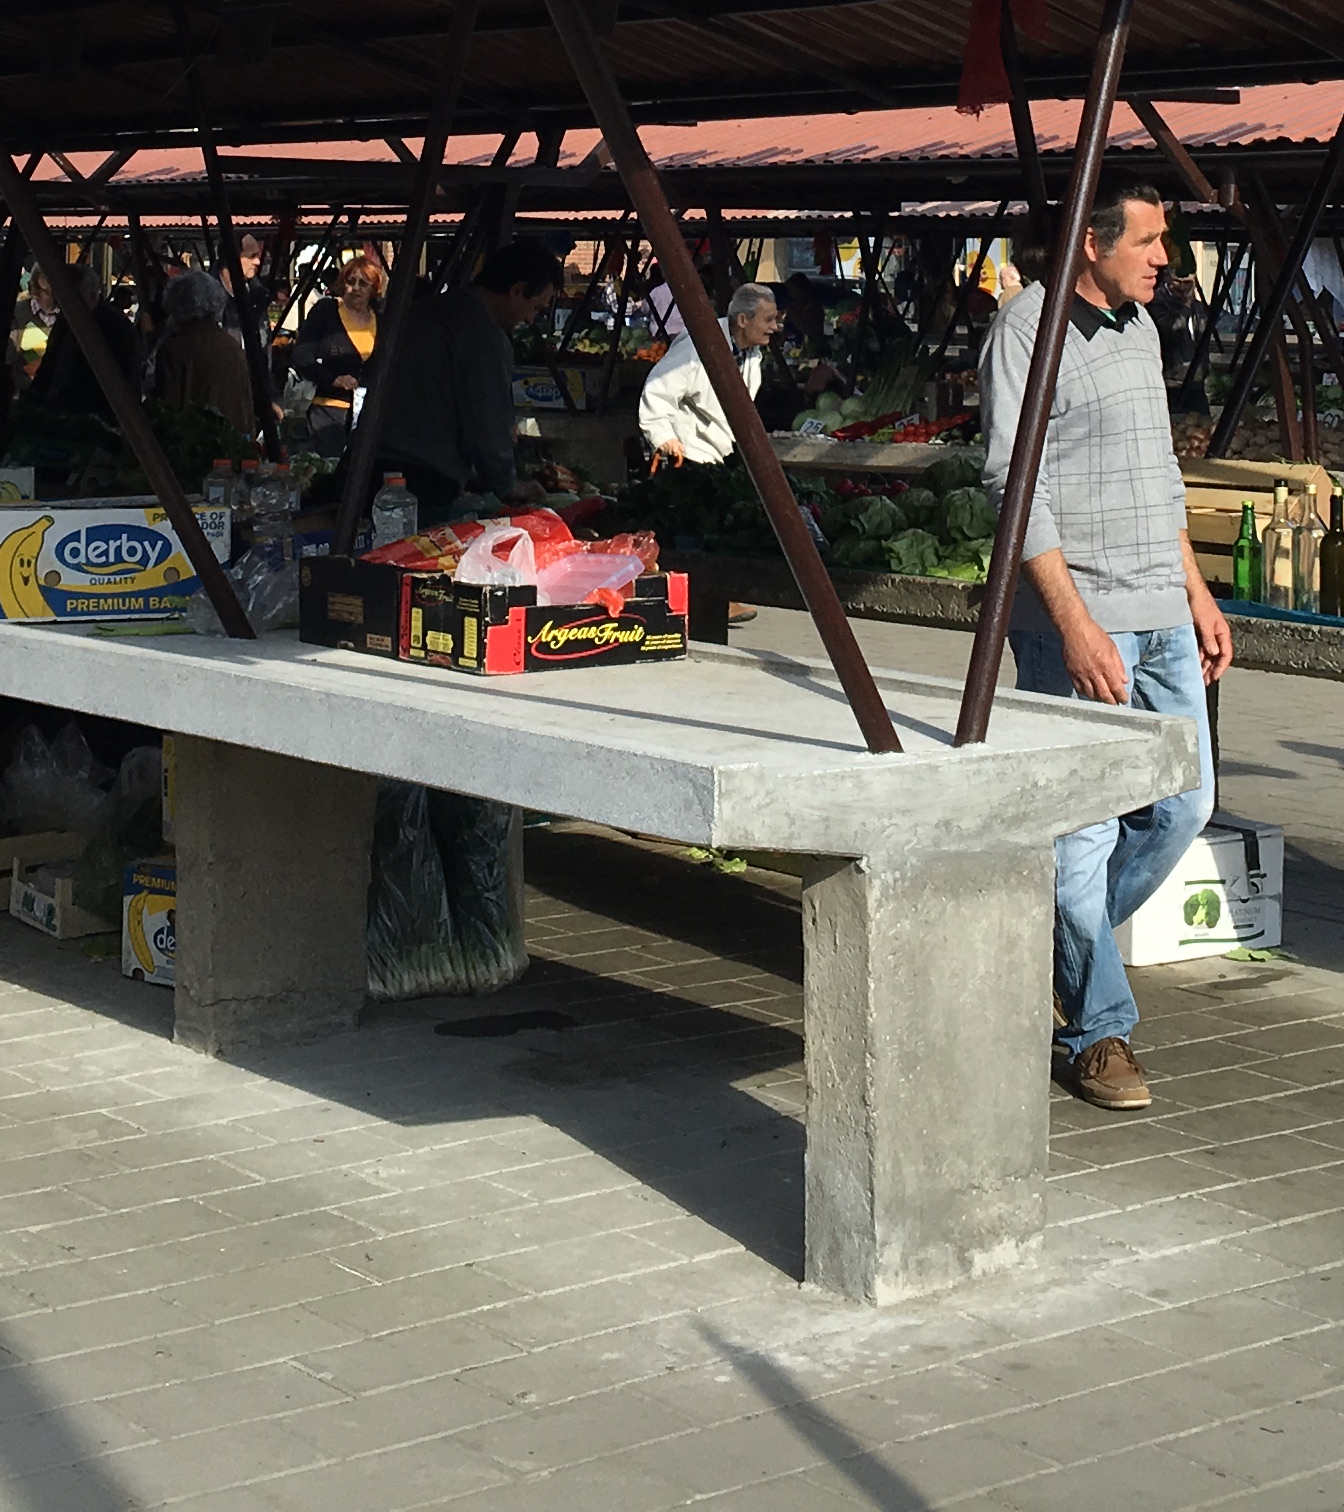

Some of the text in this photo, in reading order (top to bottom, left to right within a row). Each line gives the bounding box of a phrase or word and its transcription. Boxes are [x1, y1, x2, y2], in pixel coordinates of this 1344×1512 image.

[63, 525, 164, 571] derby
[89, 575, 137, 587] QUALITY
[66, 596, 145, 612] PREMIUM
